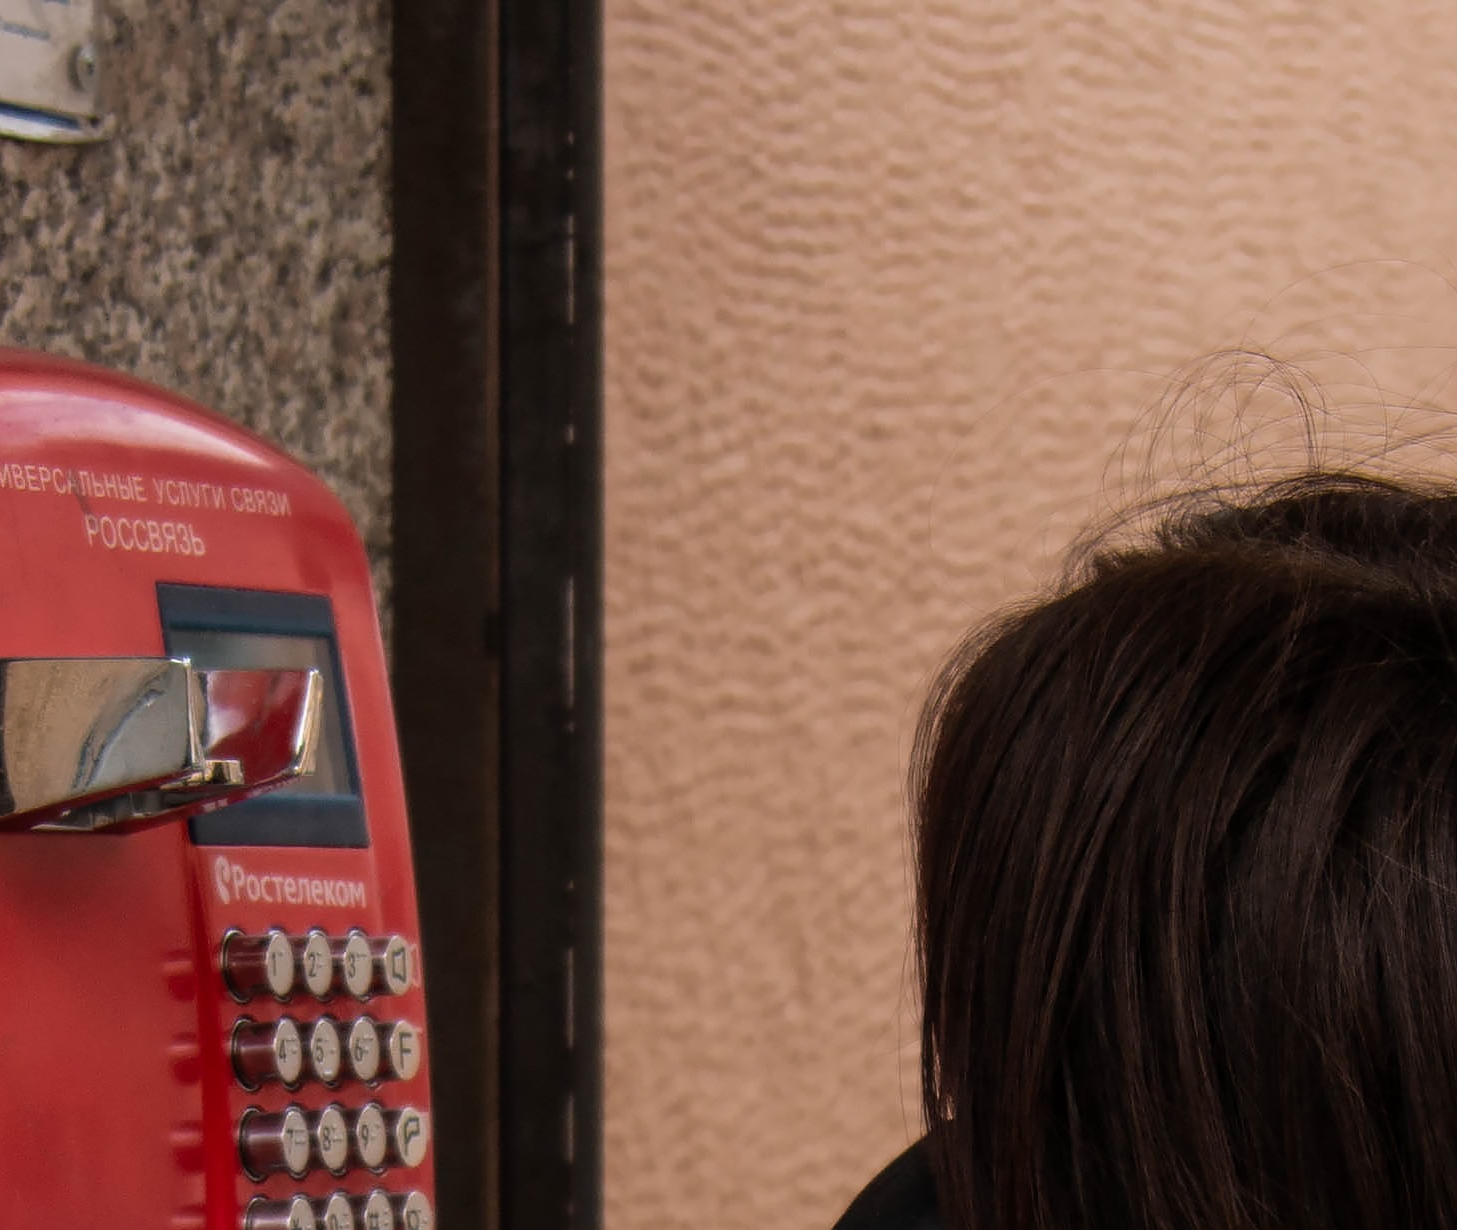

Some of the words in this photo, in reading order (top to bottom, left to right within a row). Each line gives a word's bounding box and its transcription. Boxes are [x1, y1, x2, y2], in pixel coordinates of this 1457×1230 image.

[152, 477, 226, 510] УСЛУГИ
[230, 487, 291, 517] СВЯЗИ
[84, 513, 206, 556] РОССВЯЗЬ
[230, 863, 367, 909] Ростелеком
[307, 951, 317, 978] 2
[346, 951, 356, 978] 3
[278, 1039, 288, 1063] 4
[315, 1038, 325, 1063] 5
[354, 1037, 364, 1062] 6
[398, 1031, 412, 1071] F
[322, 1125, 332, 1152] 8
[360, 1124, 369, 1151] 9
